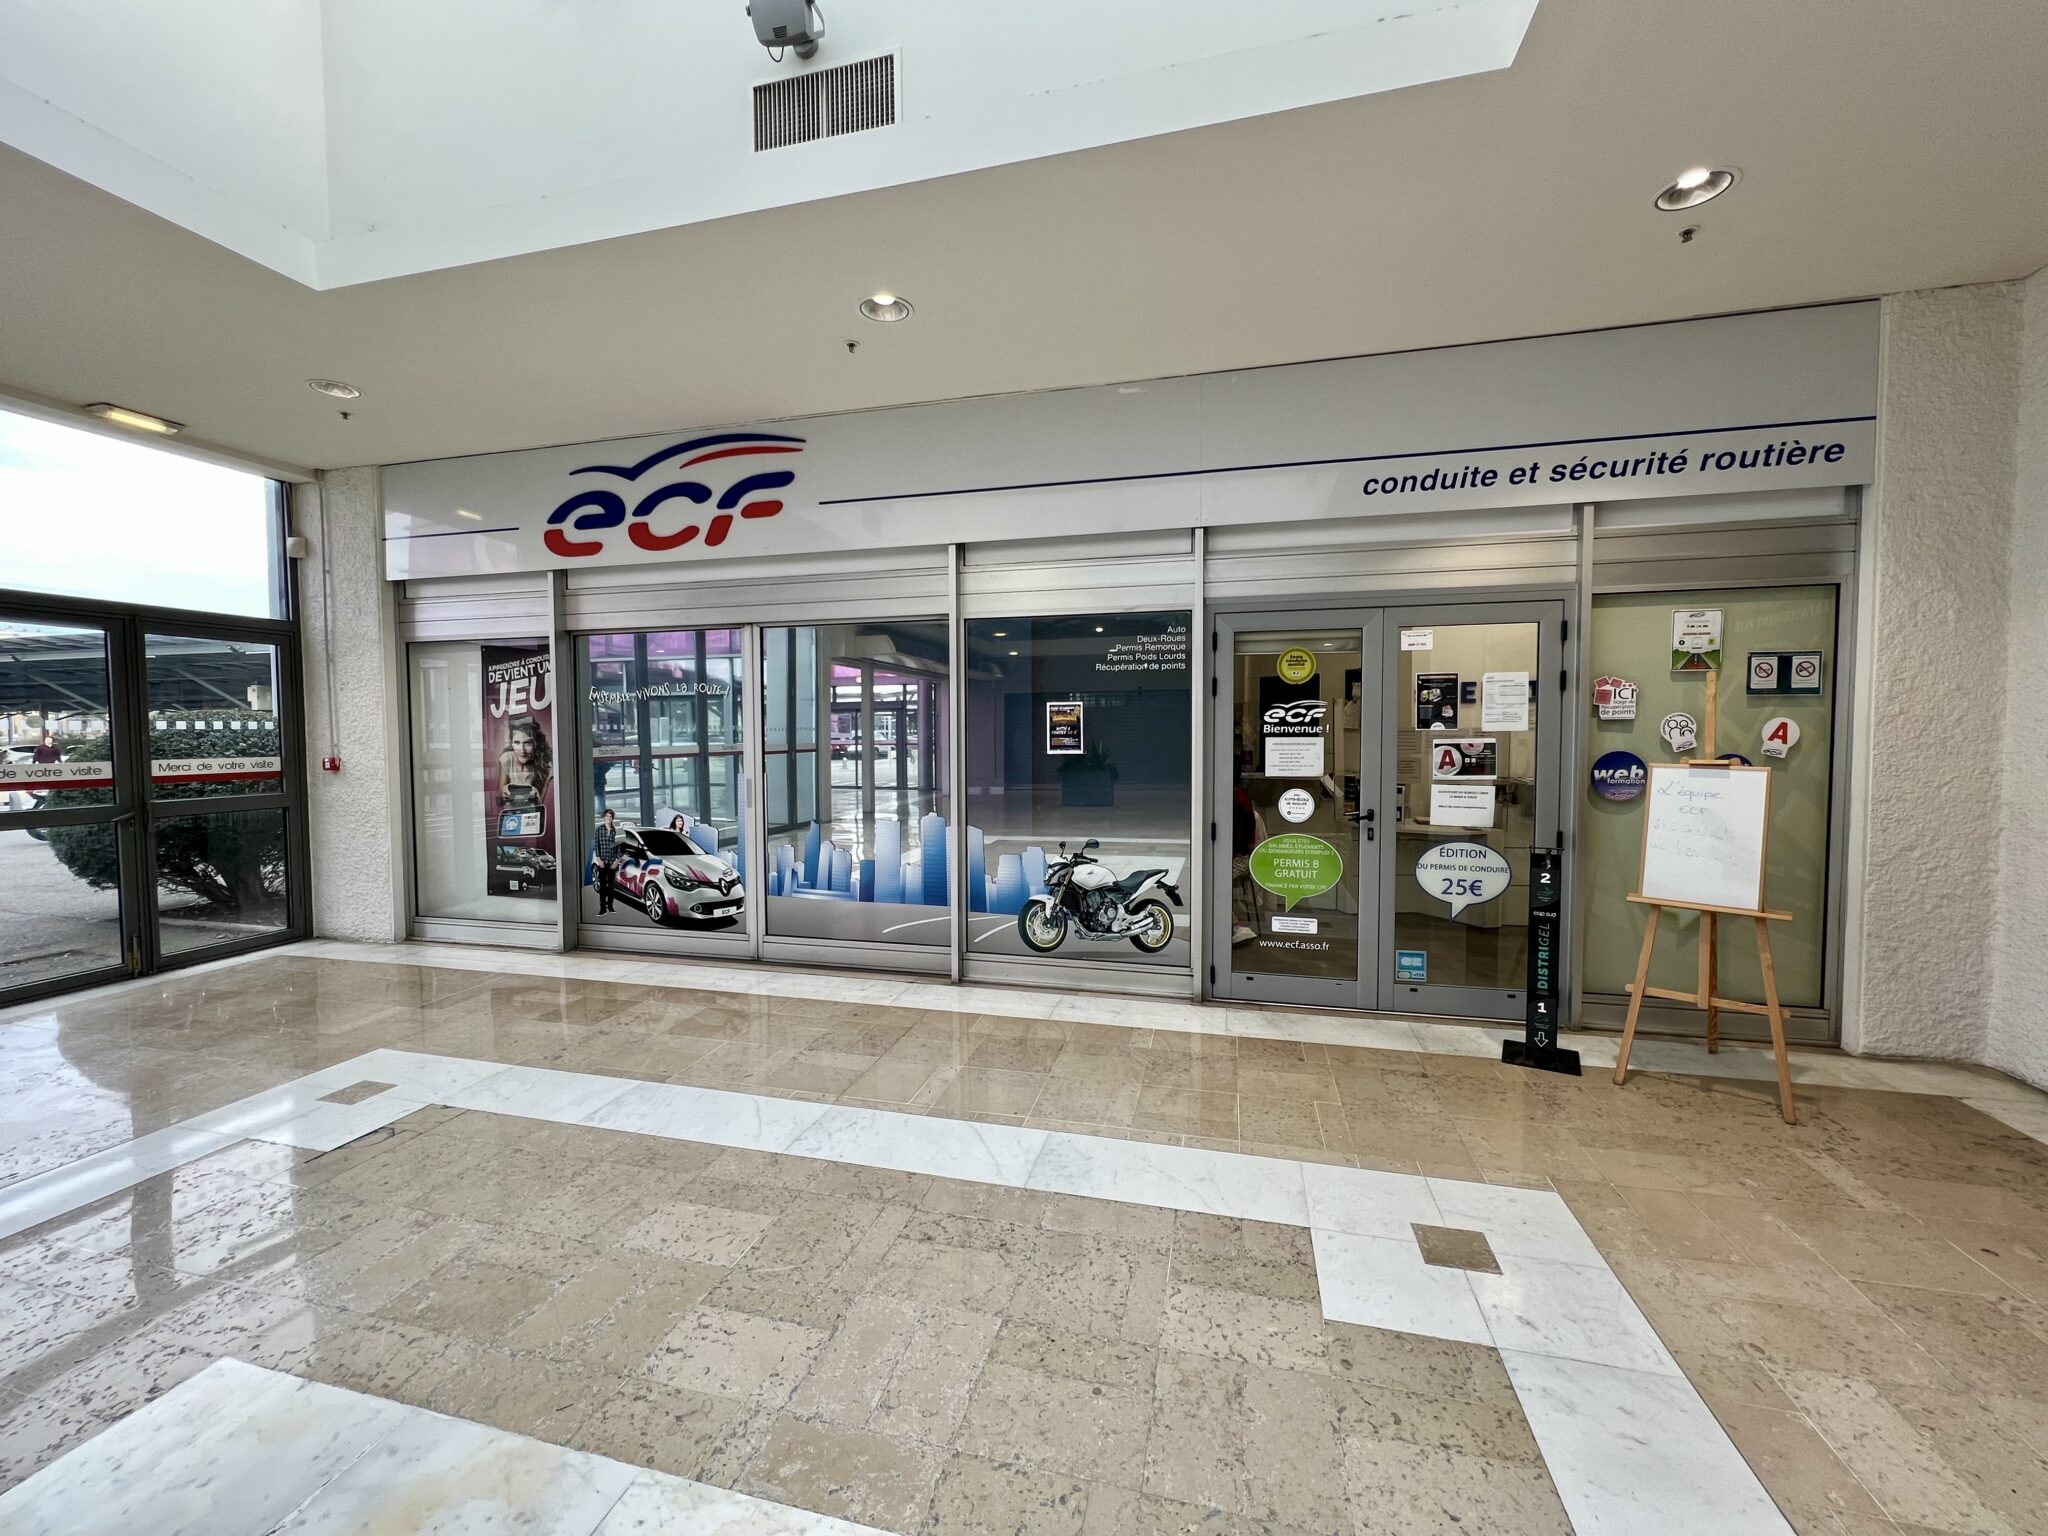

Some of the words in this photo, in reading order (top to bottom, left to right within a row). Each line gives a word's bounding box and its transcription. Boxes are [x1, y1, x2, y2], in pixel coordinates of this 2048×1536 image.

[1362, 466, 1498, 496] conduite
[1509, 461, 1540, 486] et
[1549, 448, 1689, 482] sécurité
[1699, 440, 1845, 472] routière
[1166, 625, 1186, 634] Auto
[1136, 634, 1186, 643] Deux-Roues
[1115, 643, 1143, 653] Permis
[1144, 641, 1186, 655] Remorque
[1107, 653, 1134, 661] Permis
[1135, 652, 1158, 661] Poids
[1159, 650, 1186, 660] Lourds
[1095, 662, 1147, 672] Récupération
[1161, 661, 1186, 671] points
[488, 664, 536, 684] DEVIENT
[489, 672, 552, 719] JEU
[1613, 687, 1635, 700] ICI
[1263, 723, 1323, 734] Bienvenue
[1767, 721, 1788, 745] A
[158, 762, 191, 773] Merci
[197, 762, 213, 772] de
[218, 761, 245, 771] votre
[250, 759, 275, 770] visite
[1438, 749, 1457, 770] A
[26, 767, 62, 779] votre
[71, 765, 103, 777] visite
[1593, 764, 1645, 781] web
[1607, 777, 1646, 785] formation
[1439, 846, 1487, 859] ÉDITION
[1273, 858, 1310, 869] PERMIS
[1312, 859, 1320, 869] B
[1417, 862, 1428, 870] DU
[1430, 864, 1457, 872] PERMIS
[1470, 865, 1510, 874] CONDUIRE
[1274, 869, 1318, 879] GRATUIT
[1540, 872, 1551, 884] 2
[1440, 877, 1483, 897] 25€
[1259, 940, 1330, 951] www.ecf.asso.fr
[1537, 923, 1550, 990] DISTRIGEL
[1537, 1002, 1547, 1013] 1
